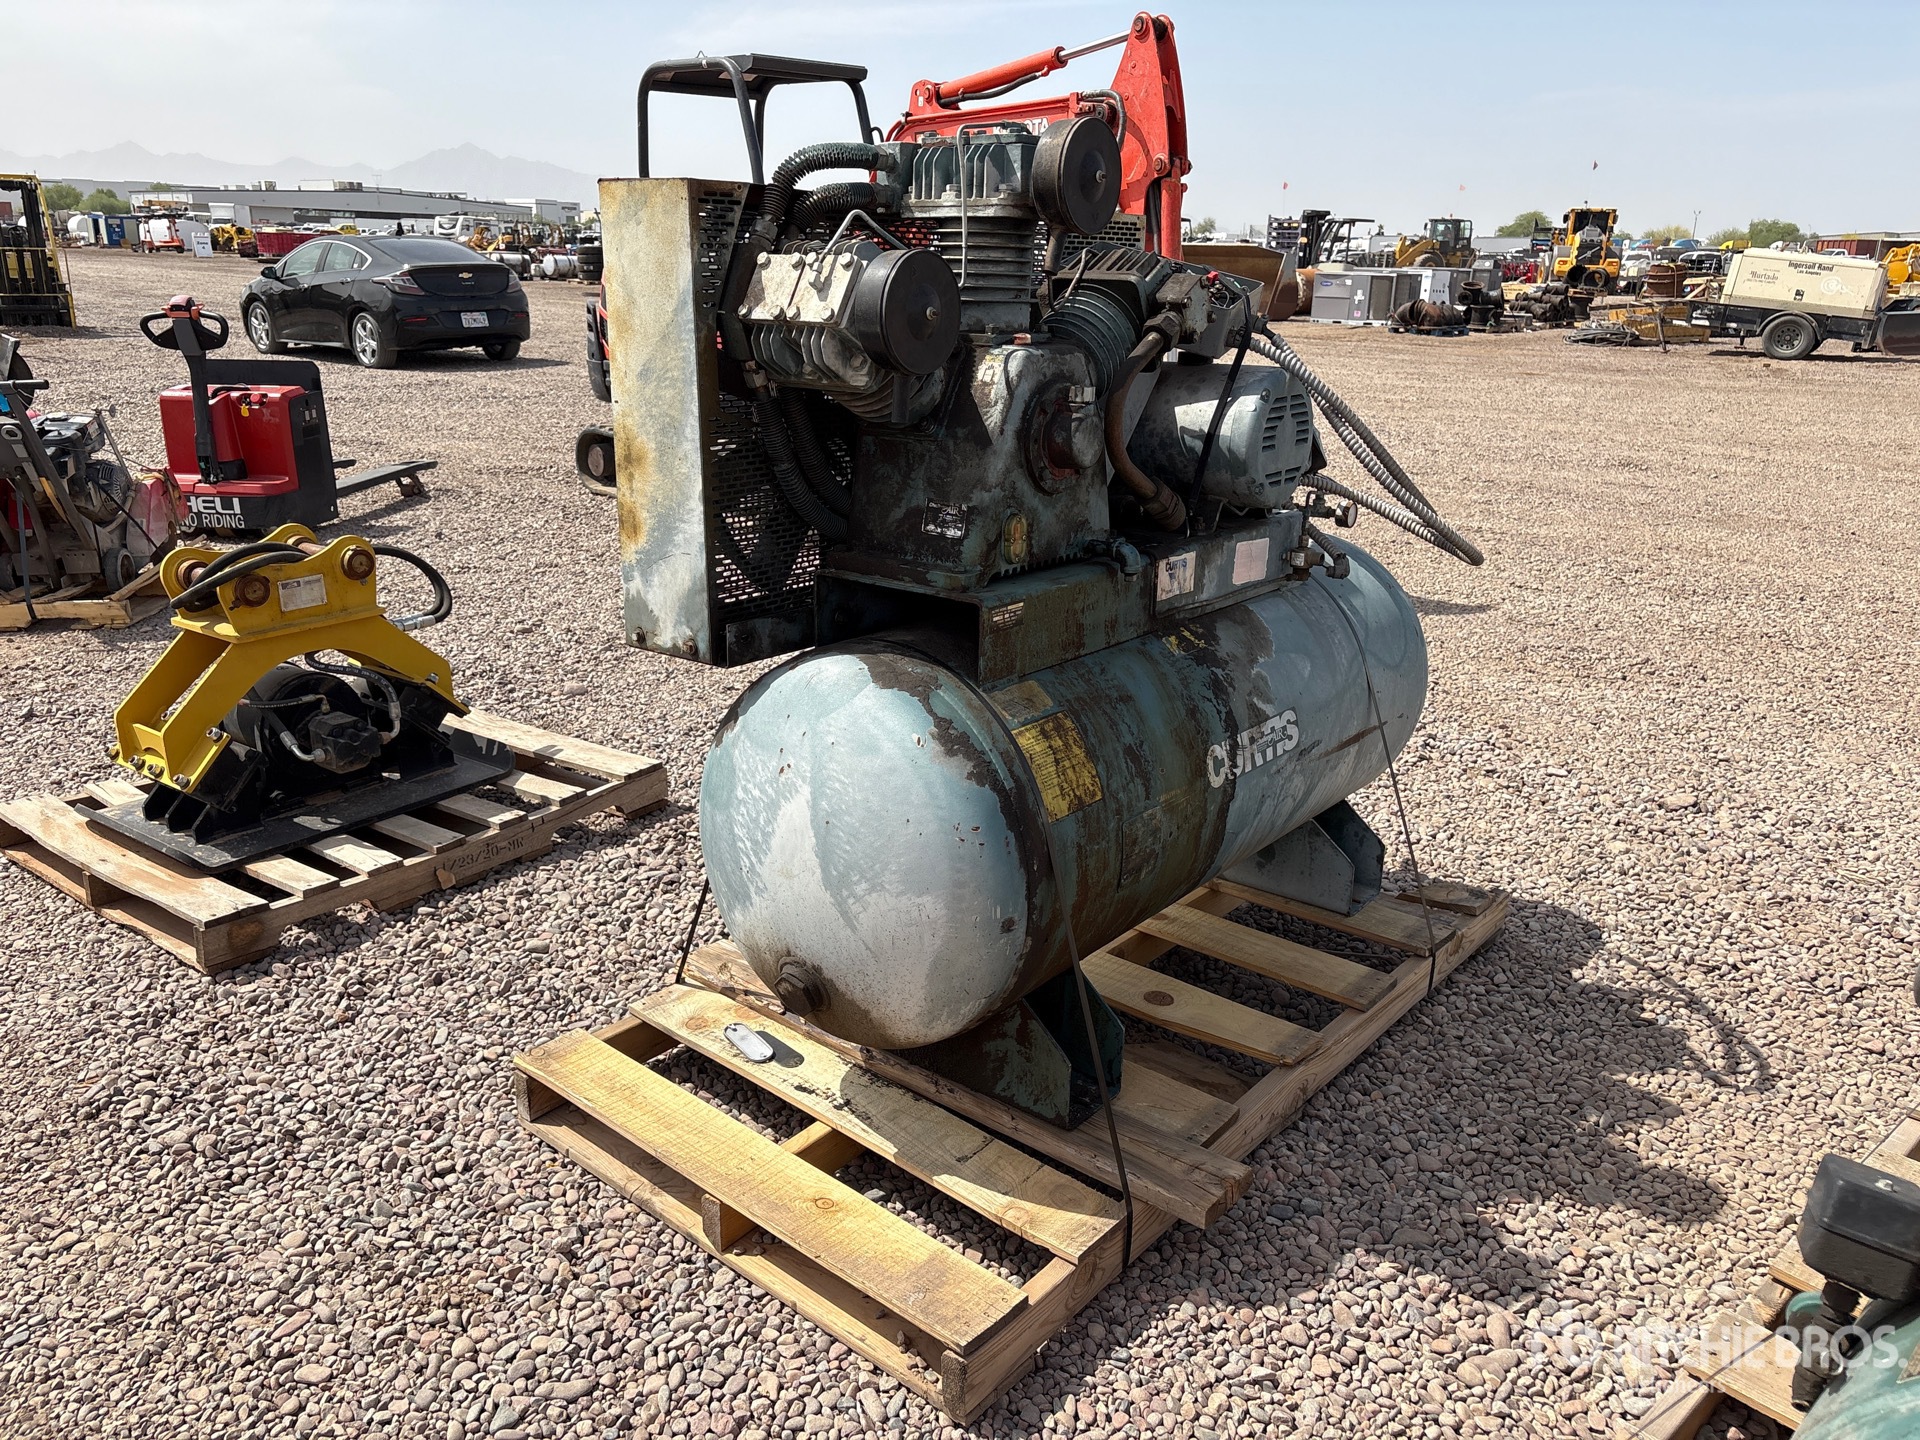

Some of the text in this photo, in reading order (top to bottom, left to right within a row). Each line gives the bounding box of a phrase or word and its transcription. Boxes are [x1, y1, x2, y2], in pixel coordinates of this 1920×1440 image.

[993, 118, 1050, 135] KOTA
[1788, 261, 1816, 271] Ingersoll
[1817, 263, 1834, 272] Rand
[186, 495, 241, 514] HELI
[182, 513, 245, 528] NO RIDING
[1207, 710, 1299, 788] CURTIS
